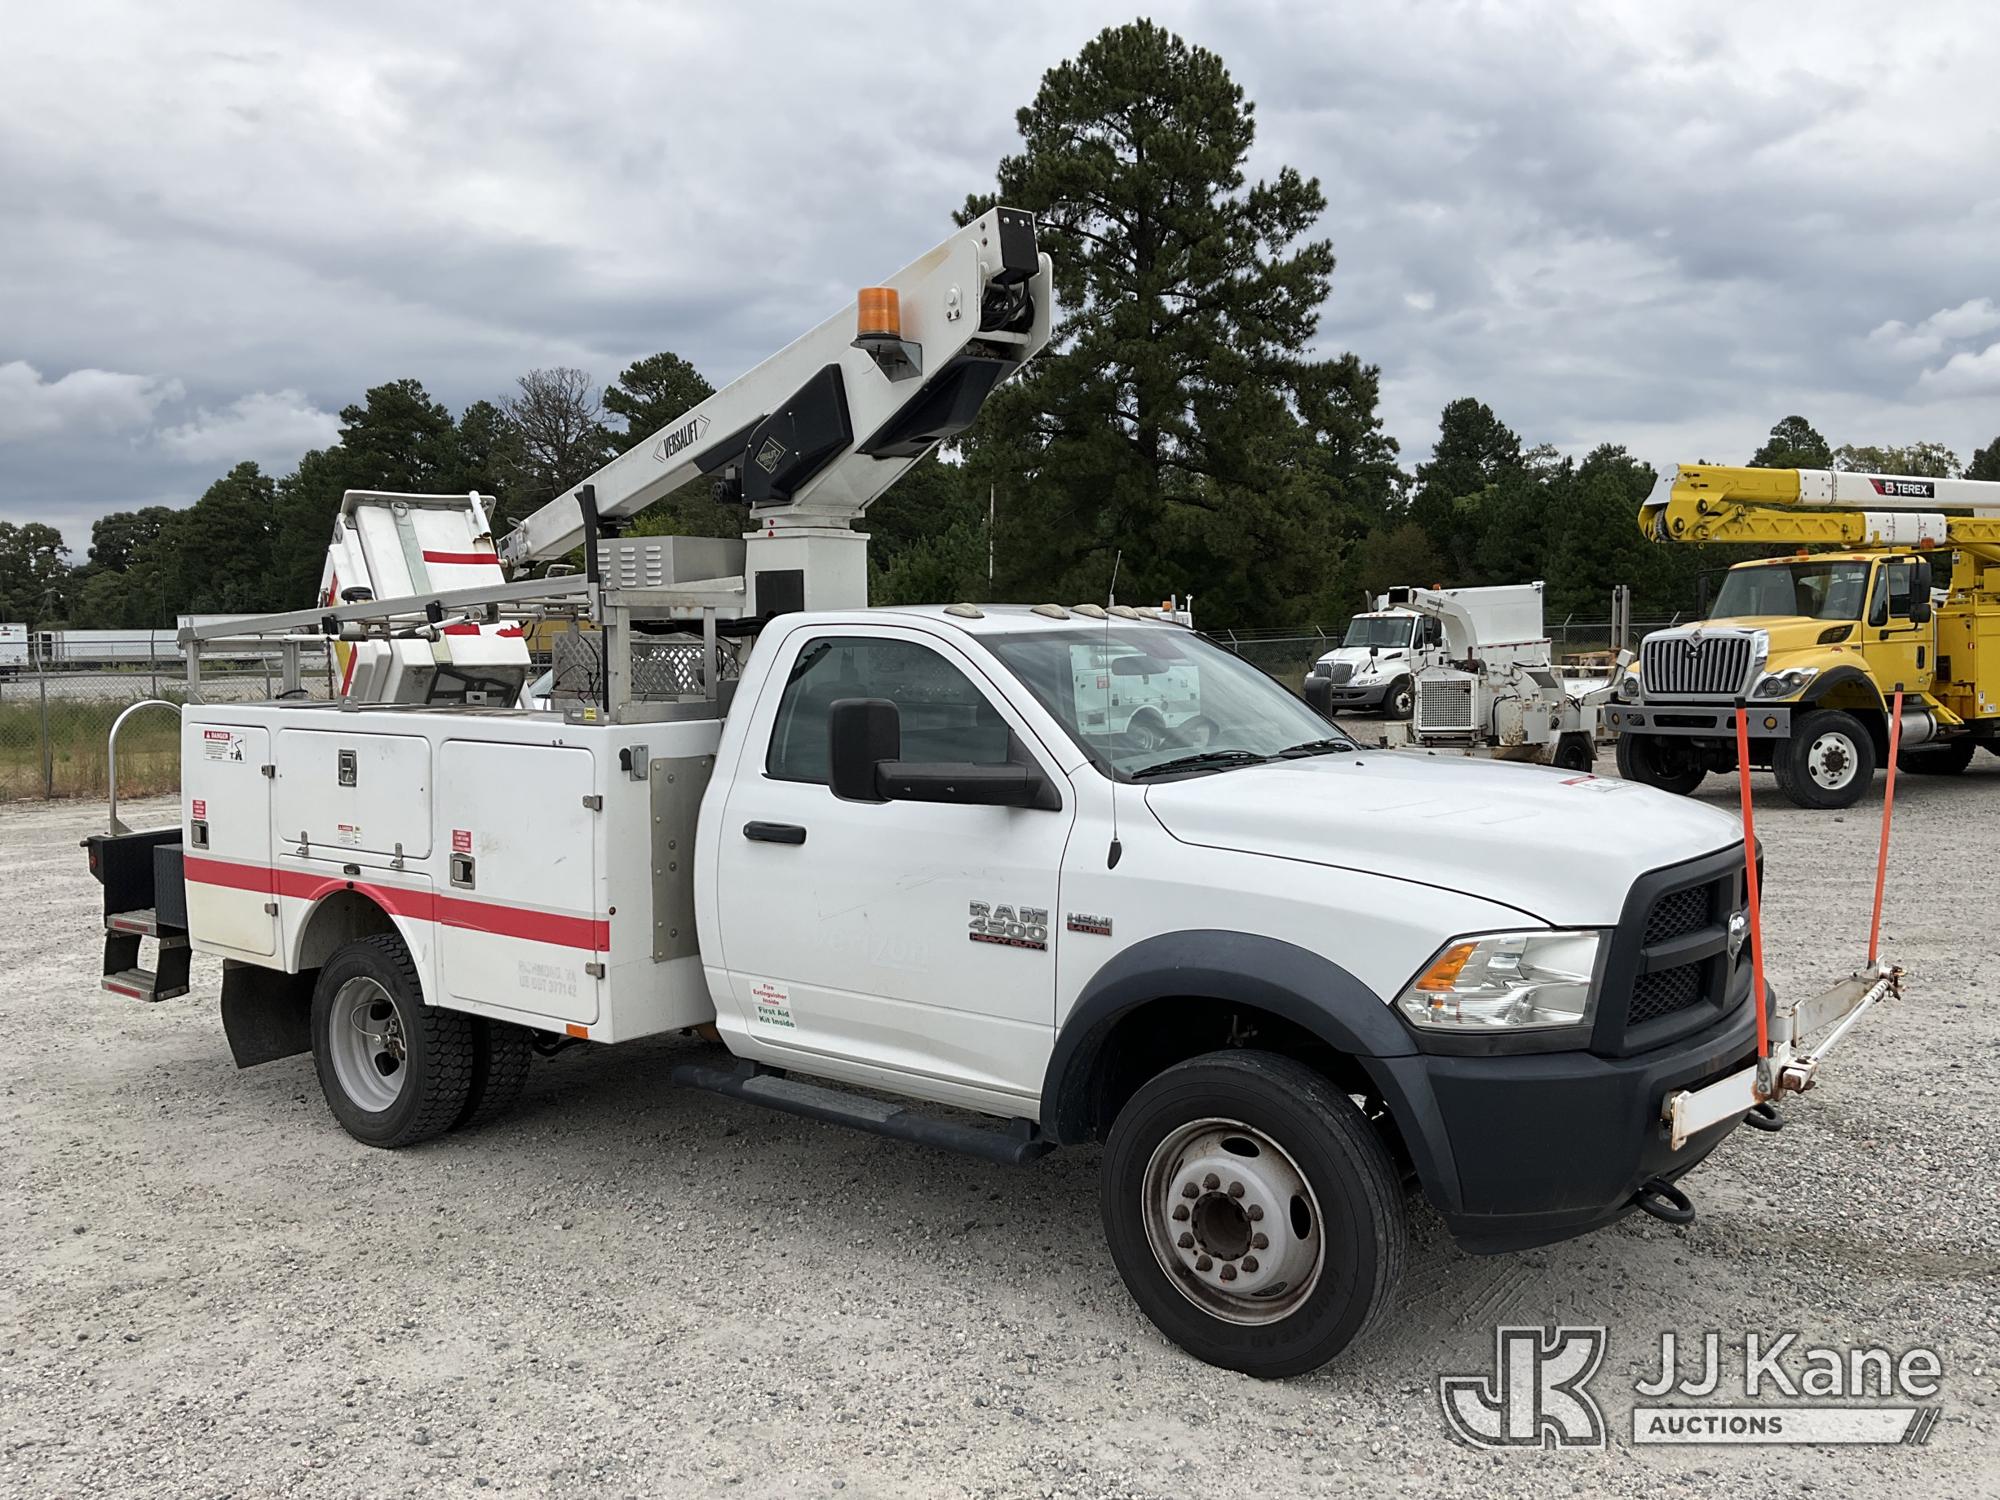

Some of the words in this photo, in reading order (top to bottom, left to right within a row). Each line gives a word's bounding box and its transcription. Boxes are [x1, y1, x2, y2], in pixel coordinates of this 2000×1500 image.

[664, 418, 698, 459] VERSALIFT
[1896, 483, 1927, 495] TEREX
[969, 899, 1048, 925] RAM
[968, 917, 1047, 941] 4500
[972, 934, 1009, 946] HEAVY
[1010, 938, 1043, 950] DUTY
[763, 983, 774, 991] Fire
[753, 988, 787, 1000] Extinguisher
[762, 998, 779, 1006] Inside
[758, 1006, 776, 1016] First
[777, 1009, 790, 1018] Aid
[759, 1016, 771, 1024] Kit
[771, 1018, 795, 1028] Inside
